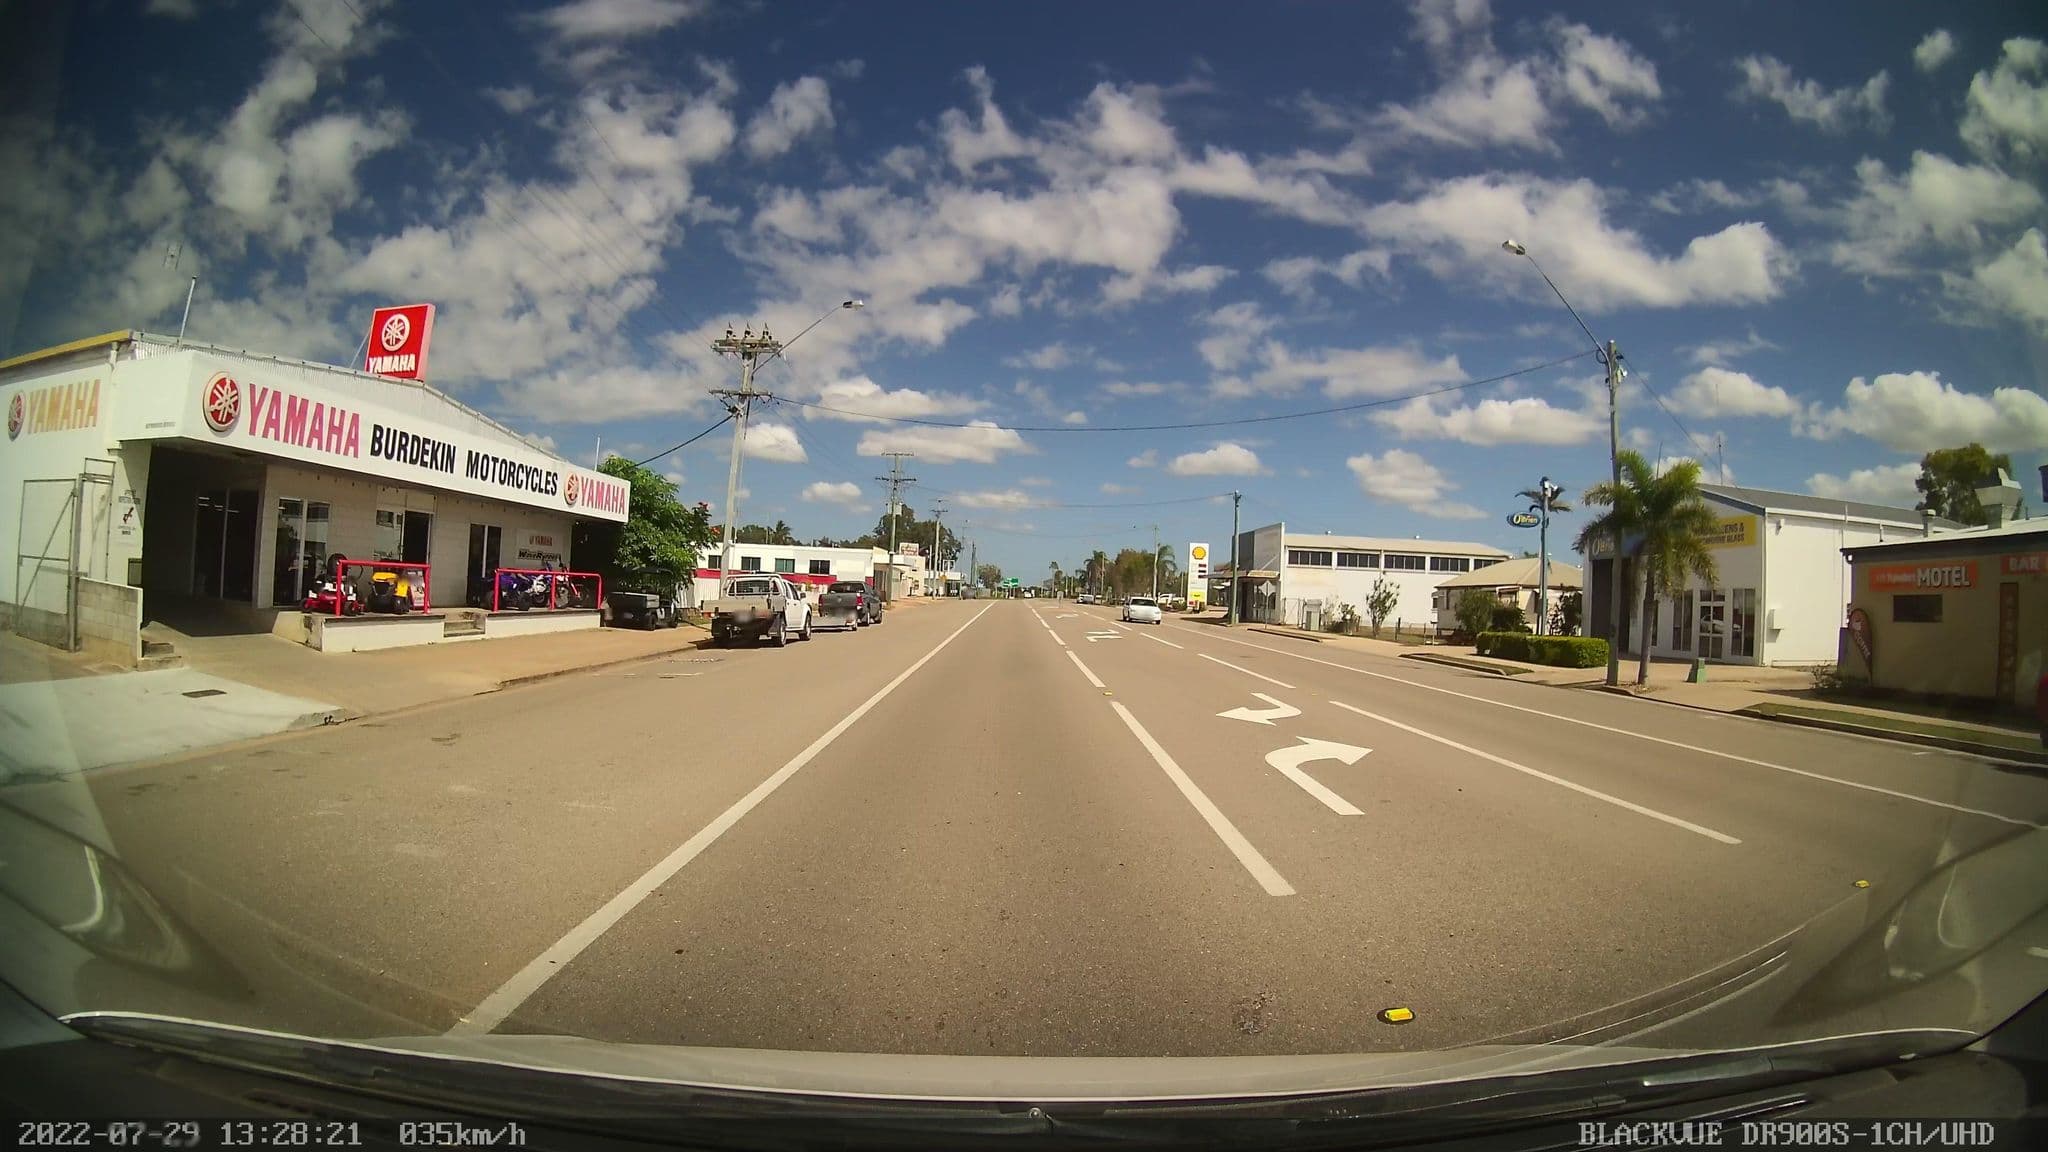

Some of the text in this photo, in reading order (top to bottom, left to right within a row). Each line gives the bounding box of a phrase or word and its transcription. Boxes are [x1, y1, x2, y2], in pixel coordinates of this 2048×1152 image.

[369, 353, 416, 374] YAMAHA
[27, 378, 101, 434] YAMAHA
[248, 383, 626, 515] YAMAHA BURDEKIN MOTORCYCLES YAMAHA
[2009, 556, 2041, 571] BAR
[1916, 565, 1970, 588] MOTEL
